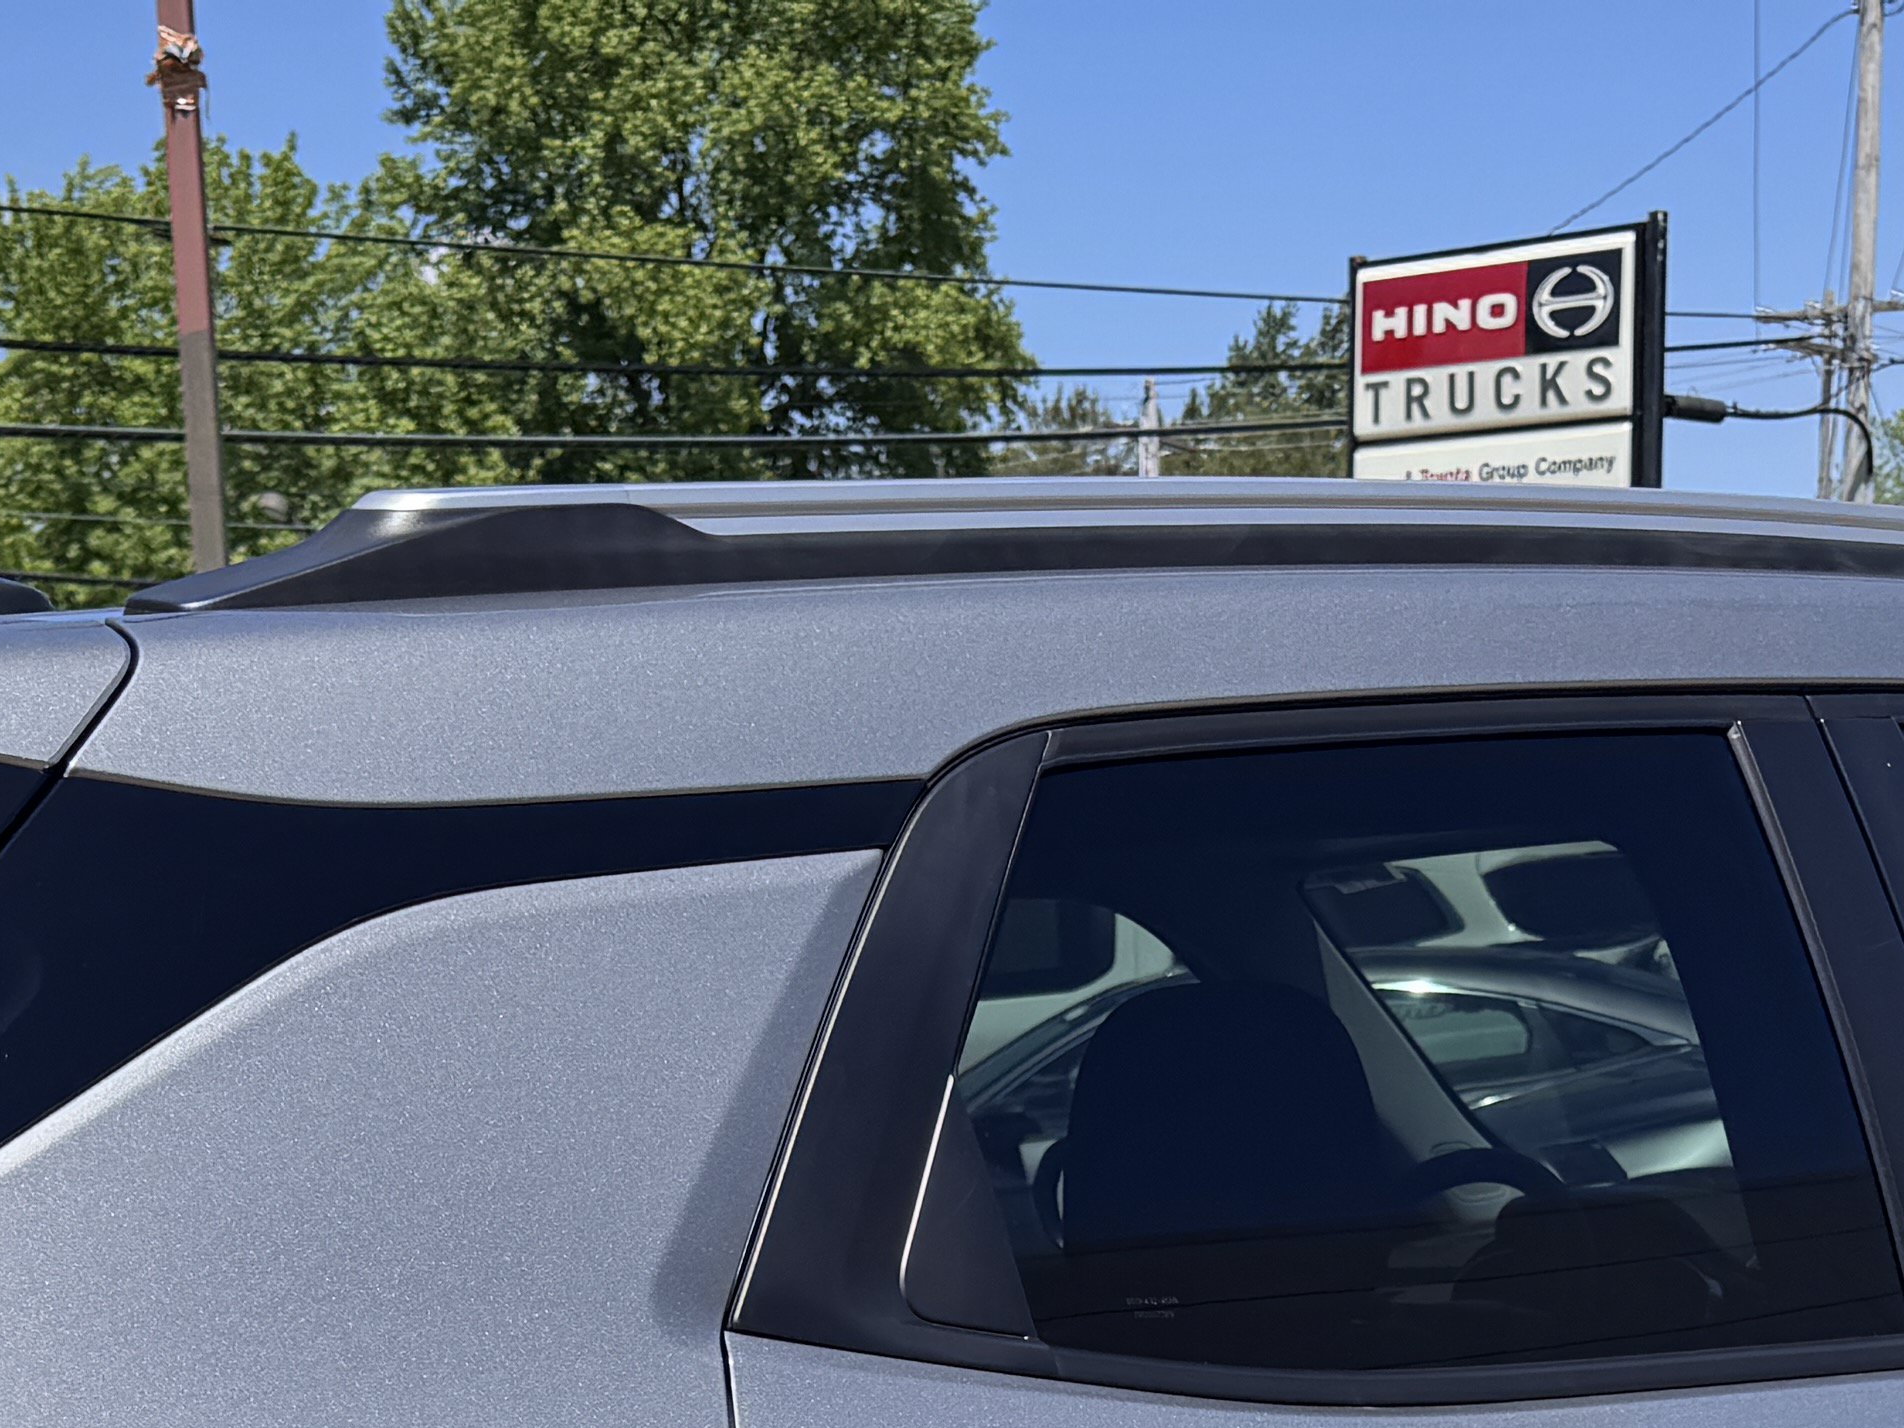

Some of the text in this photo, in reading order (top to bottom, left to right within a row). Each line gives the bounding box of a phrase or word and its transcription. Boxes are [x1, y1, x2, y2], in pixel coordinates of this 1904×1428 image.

[1371, 292, 1518, 342] HINO
[1364, 355, 1613, 426] TRUCKS
[1478, 462, 1528, 482] Group
[1534, 454, 1616, 477] Company
